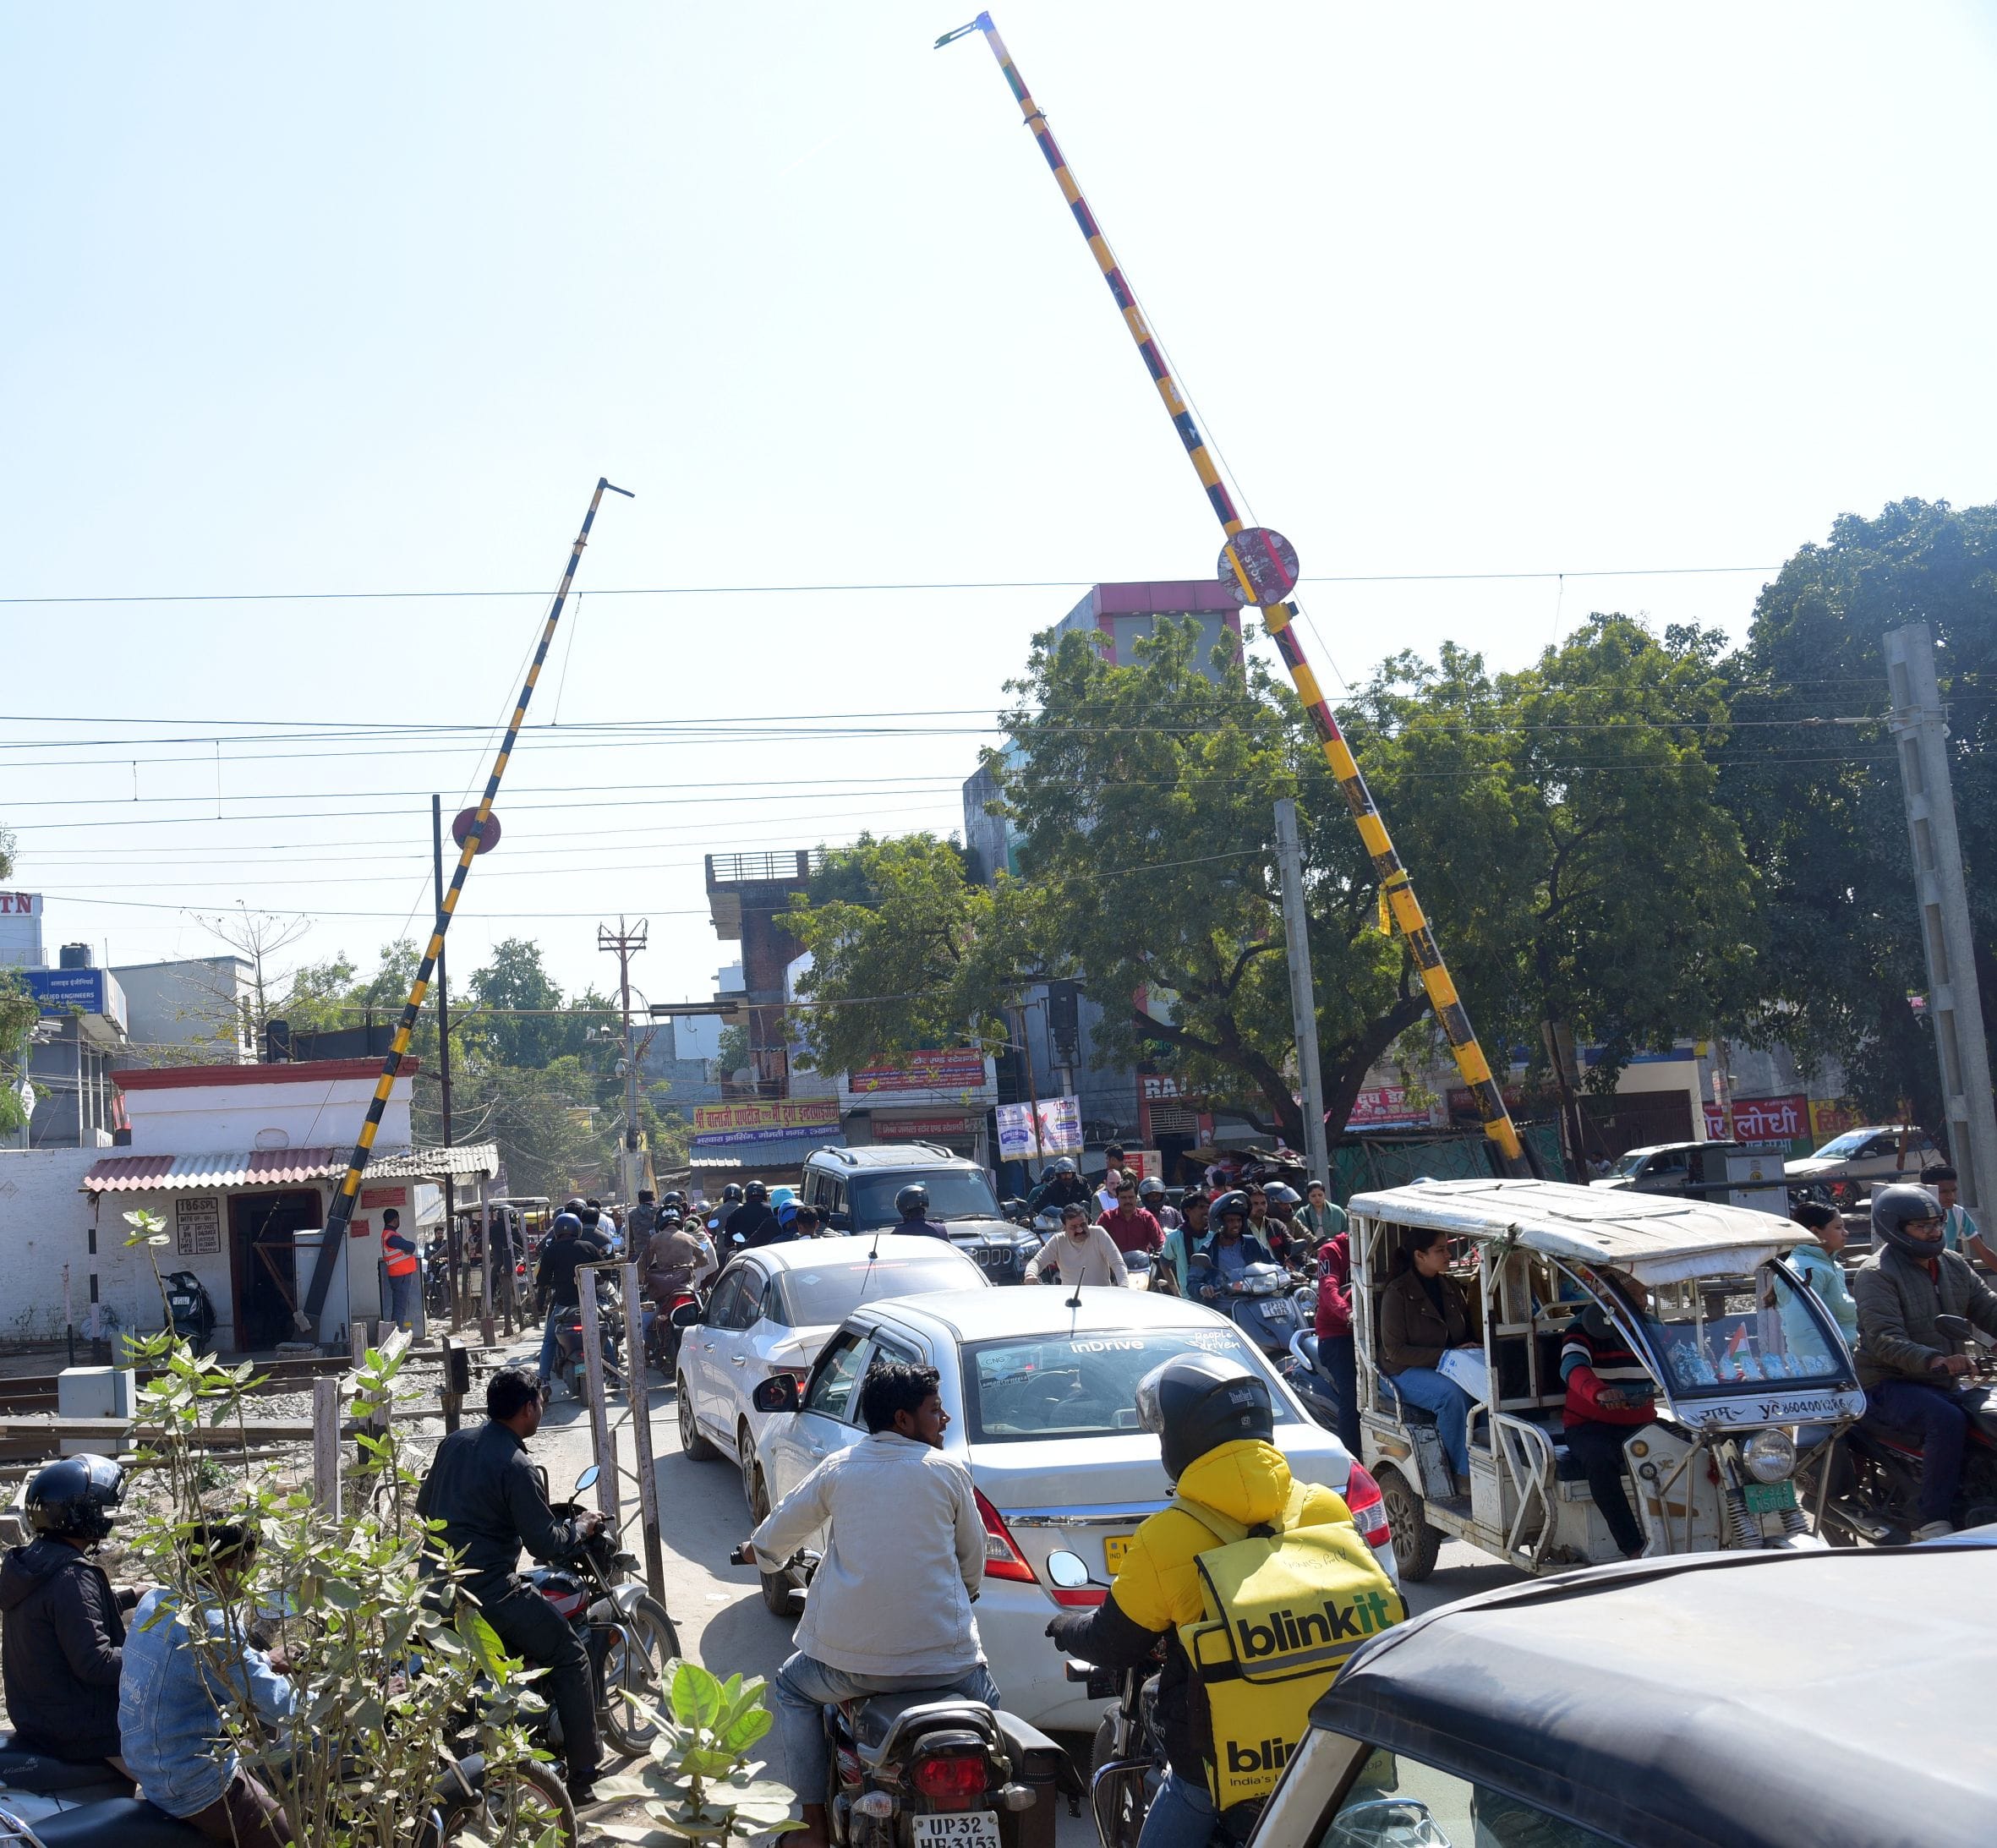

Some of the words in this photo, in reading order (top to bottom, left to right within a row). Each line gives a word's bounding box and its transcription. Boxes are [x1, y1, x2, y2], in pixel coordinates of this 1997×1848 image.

[1733, 1105, 1798, 1137] लोधी
[758, 1129, 784, 1139] गोमती
[1194, 1330, 1234, 1342] people
[1070, 1337, 1146, 1353] inDrive
[1198, 1339, 1241, 1352] driven
[985, 1356, 1005, 1365] CNG
[1236, 1591, 1395, 1659] blinkit
[1230, 1775, 1272, 1786] India's
